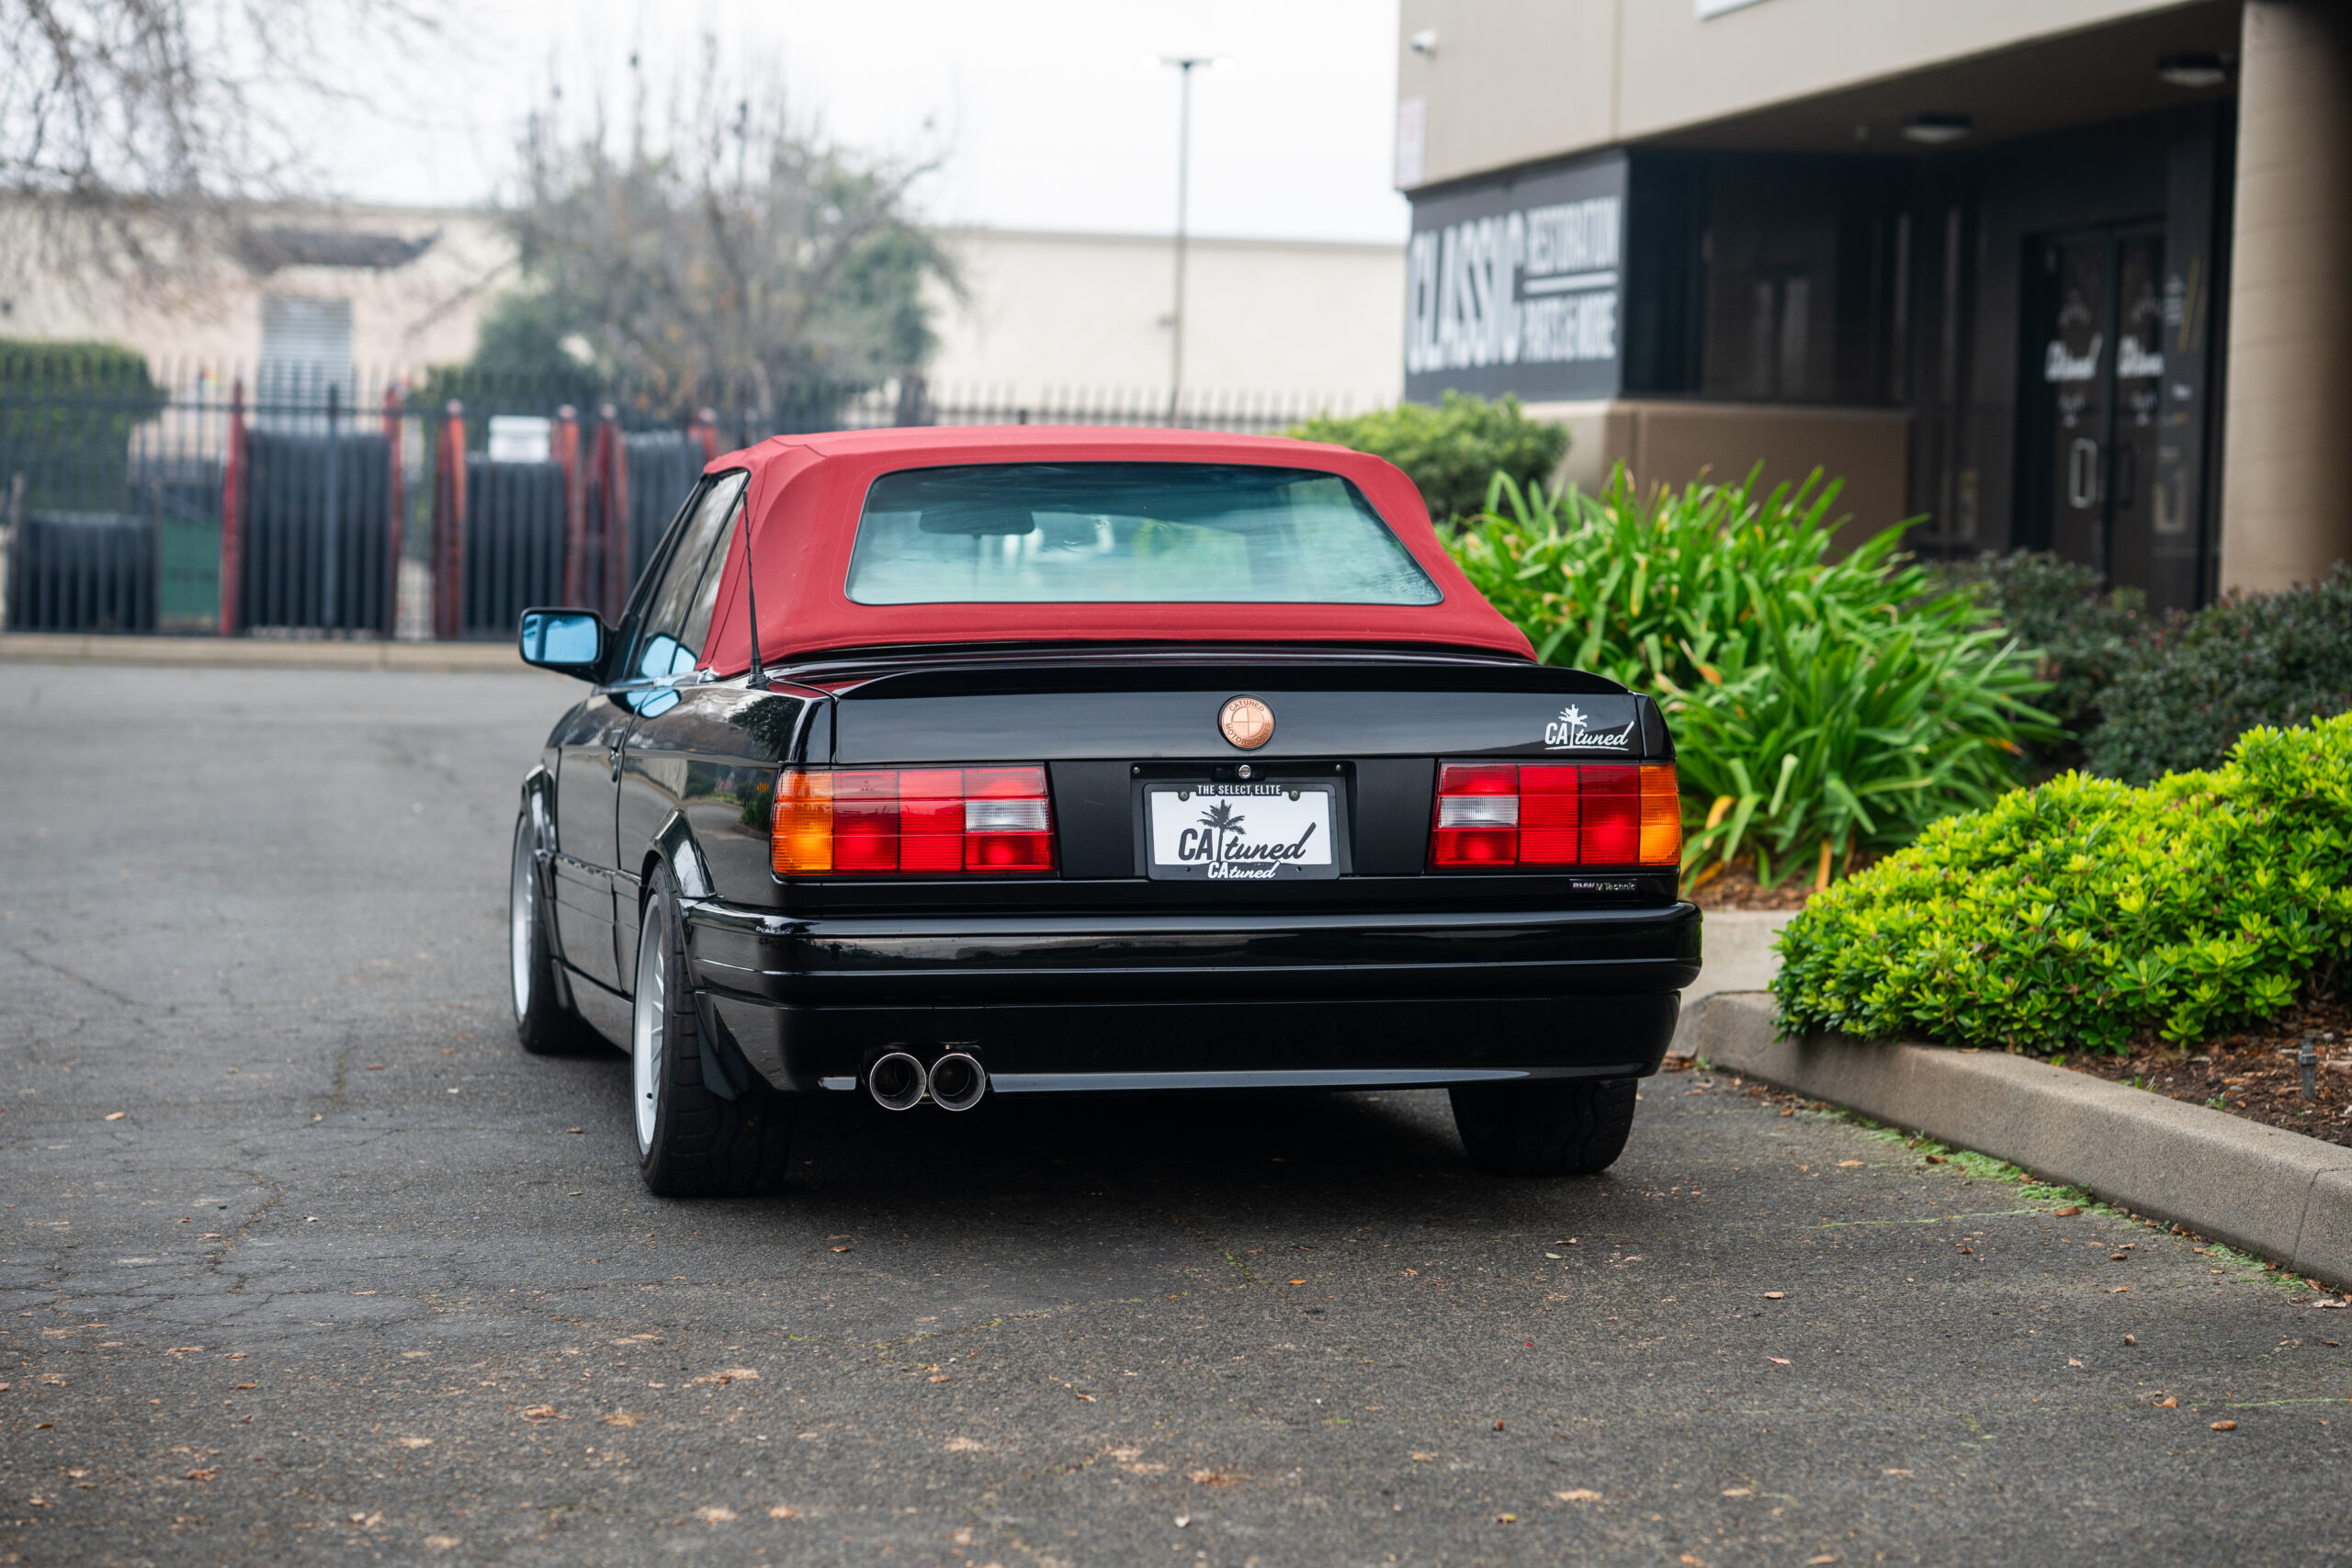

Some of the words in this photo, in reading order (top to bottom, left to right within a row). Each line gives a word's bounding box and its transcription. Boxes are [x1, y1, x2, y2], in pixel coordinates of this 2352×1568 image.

[1408, 211, 1524, 374] CLASSIC
[1228, 700, 1265, 712] CATUNED
[1224, 722, 1271, 746] MOTORSPORTS
[1197, 784, 1216, 795] THE
[1218, 784, 1252, 795] SELECT
[1254, 784, 1282, 795] ELITE
[1207, 861, 1281, 879] CAtuned
[1604, 882, 1636, 891] Technic
